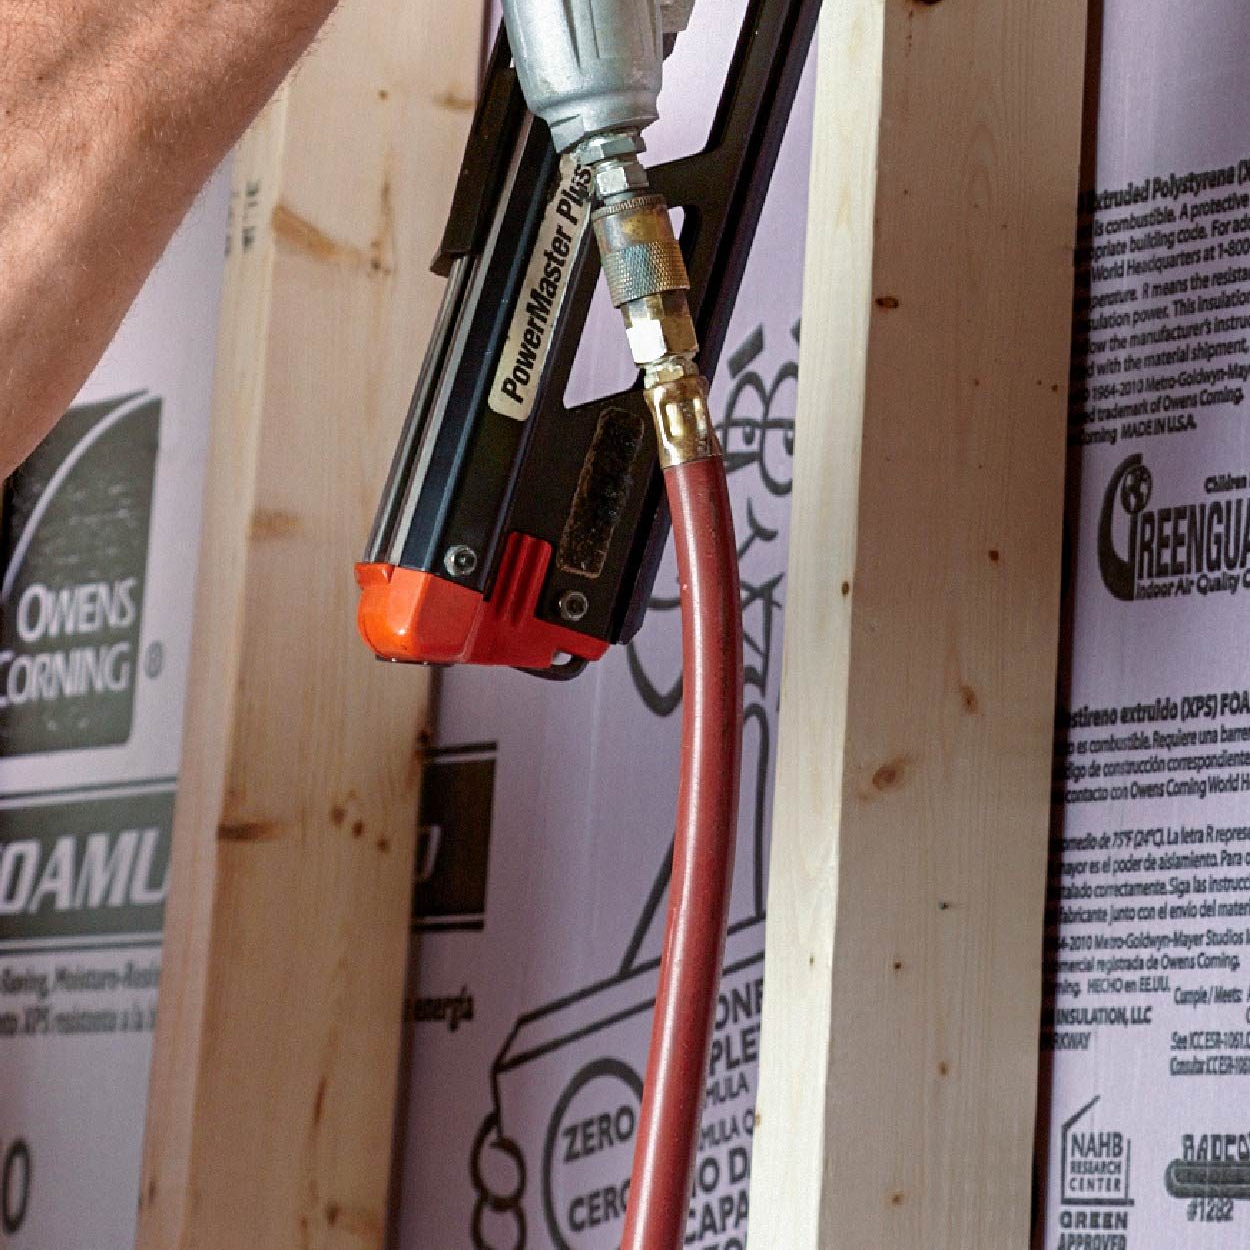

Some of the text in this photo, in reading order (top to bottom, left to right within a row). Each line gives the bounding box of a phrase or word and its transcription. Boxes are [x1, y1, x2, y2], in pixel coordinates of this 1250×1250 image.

[501, 163, 594, 404] PowerMaster Plus
[1196, 572, 1240, 595] Quality
[16, 578, 137, 642] OWENS
[562, 1106, 635, 1163] ZERO
[1070, 1131, 1124, 1159] NAHB
[1070, 1161, 1121, 1175] RESEARCH
[1069, 1177, 1121, 1192] CENTER
[1059, 1211, 1129, 1230] GREEN
